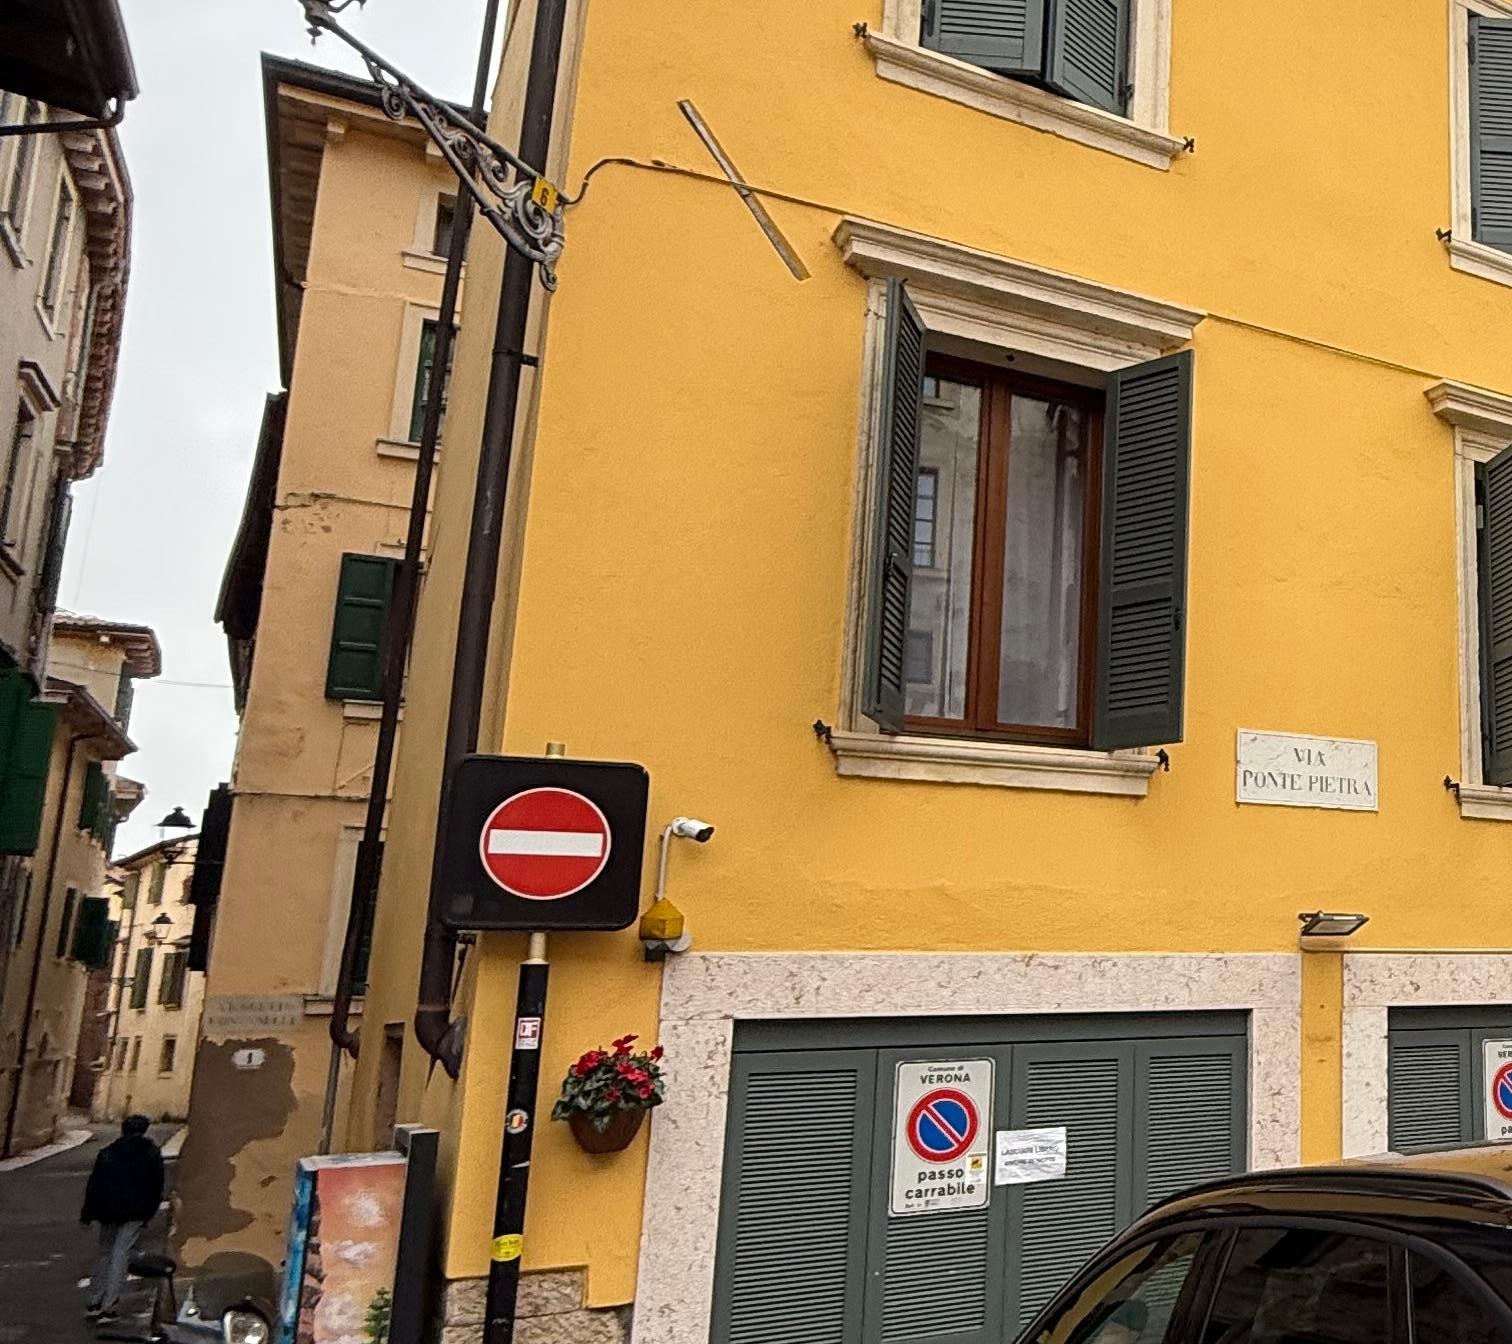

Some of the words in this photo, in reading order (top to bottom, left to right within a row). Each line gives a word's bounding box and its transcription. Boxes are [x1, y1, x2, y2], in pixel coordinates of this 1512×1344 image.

[1293, 747, 1326, 767] VIA
[1242, 769, 1303, 791] PONTE
[1308, 775, 1372, 796] PIETRA
[246, 1052, 253, 1065] 1
[920, 1073, 971, 1085] VERONA
[917, 1168, 964, 1184] passo
[905, 1182, 976, 1199] carrabile
